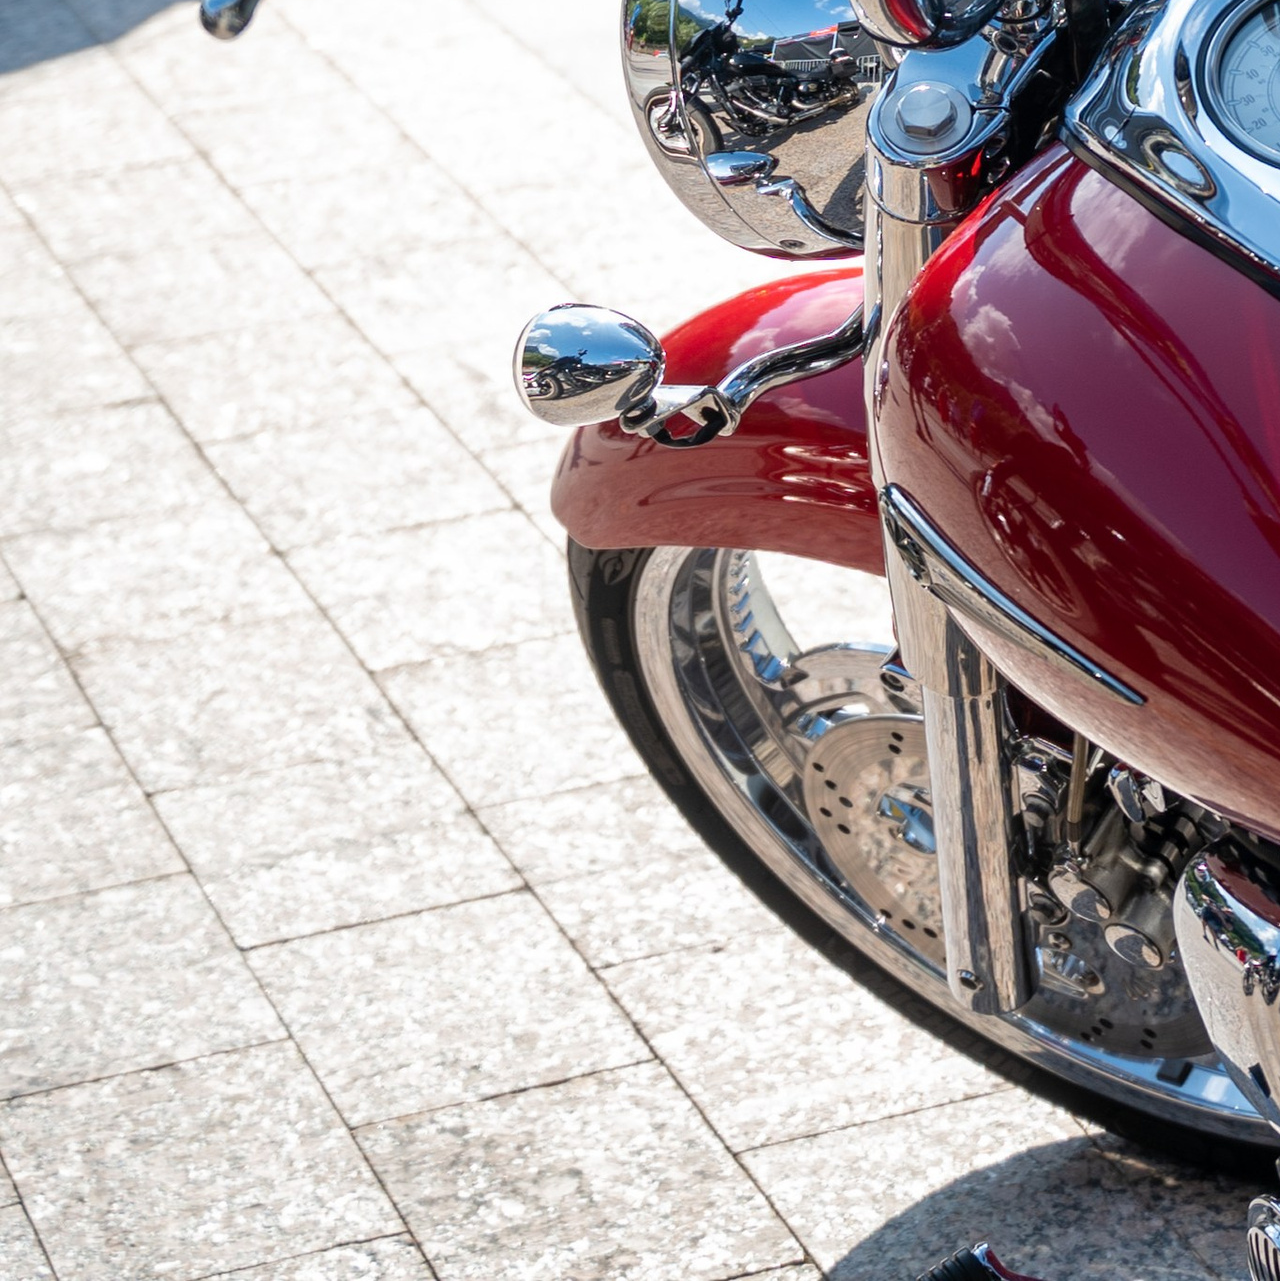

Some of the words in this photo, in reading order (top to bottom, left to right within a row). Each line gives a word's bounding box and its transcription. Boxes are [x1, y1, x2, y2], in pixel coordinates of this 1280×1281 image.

[1261, 45, 1275, 57] 50
[1246, 68, 1259, 80] 40
[1241, 94, 1255, 106] 30
[1252, 118, 1267, 130] 20
